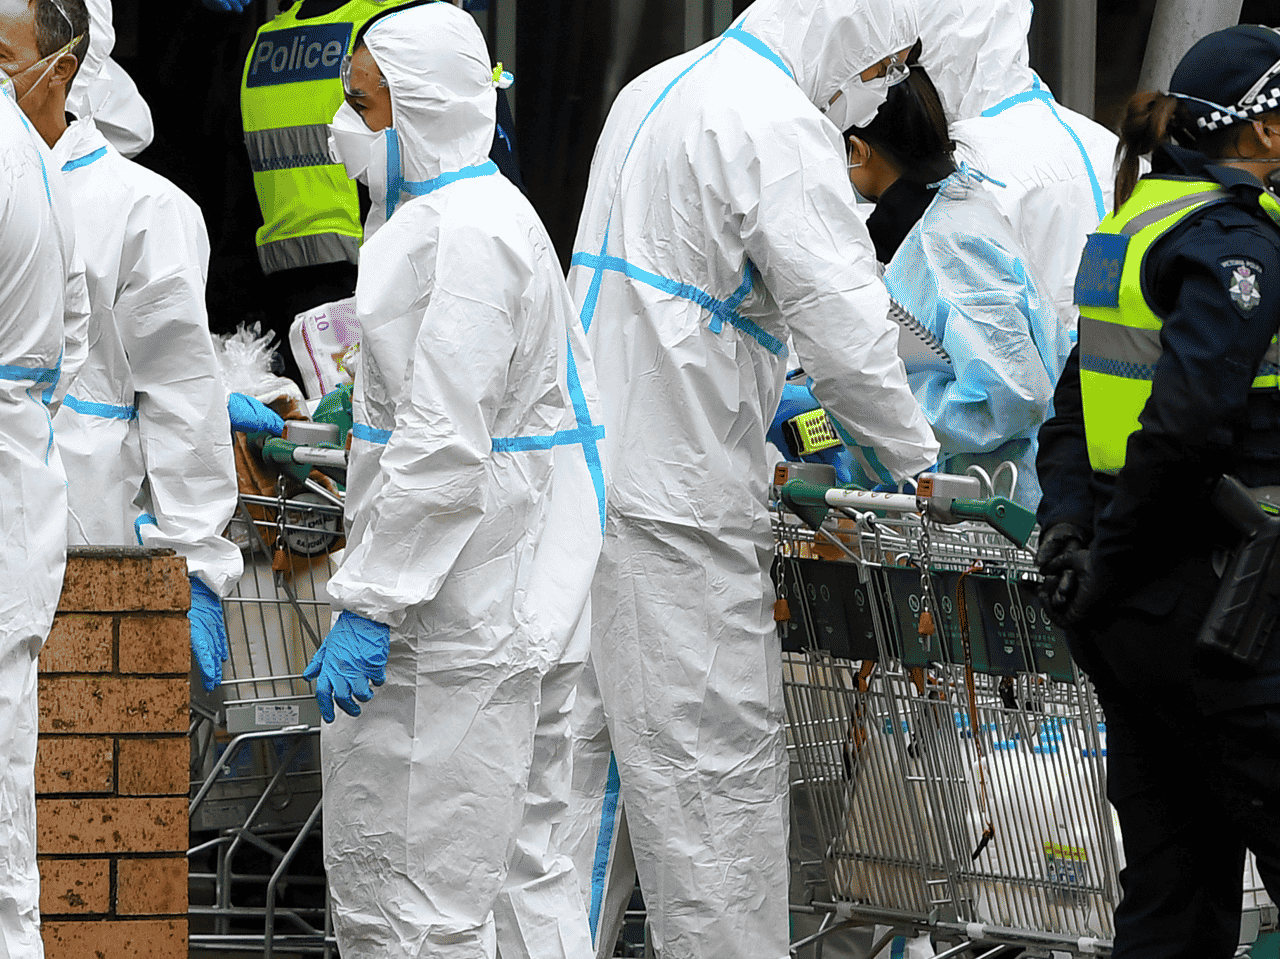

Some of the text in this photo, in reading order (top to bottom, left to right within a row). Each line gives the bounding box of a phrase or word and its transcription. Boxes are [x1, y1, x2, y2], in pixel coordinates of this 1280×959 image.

[252, 35, 342, 75] Police
[1010, 159, 1086, 192] HALL
[314, 314, 330, 332] 10
